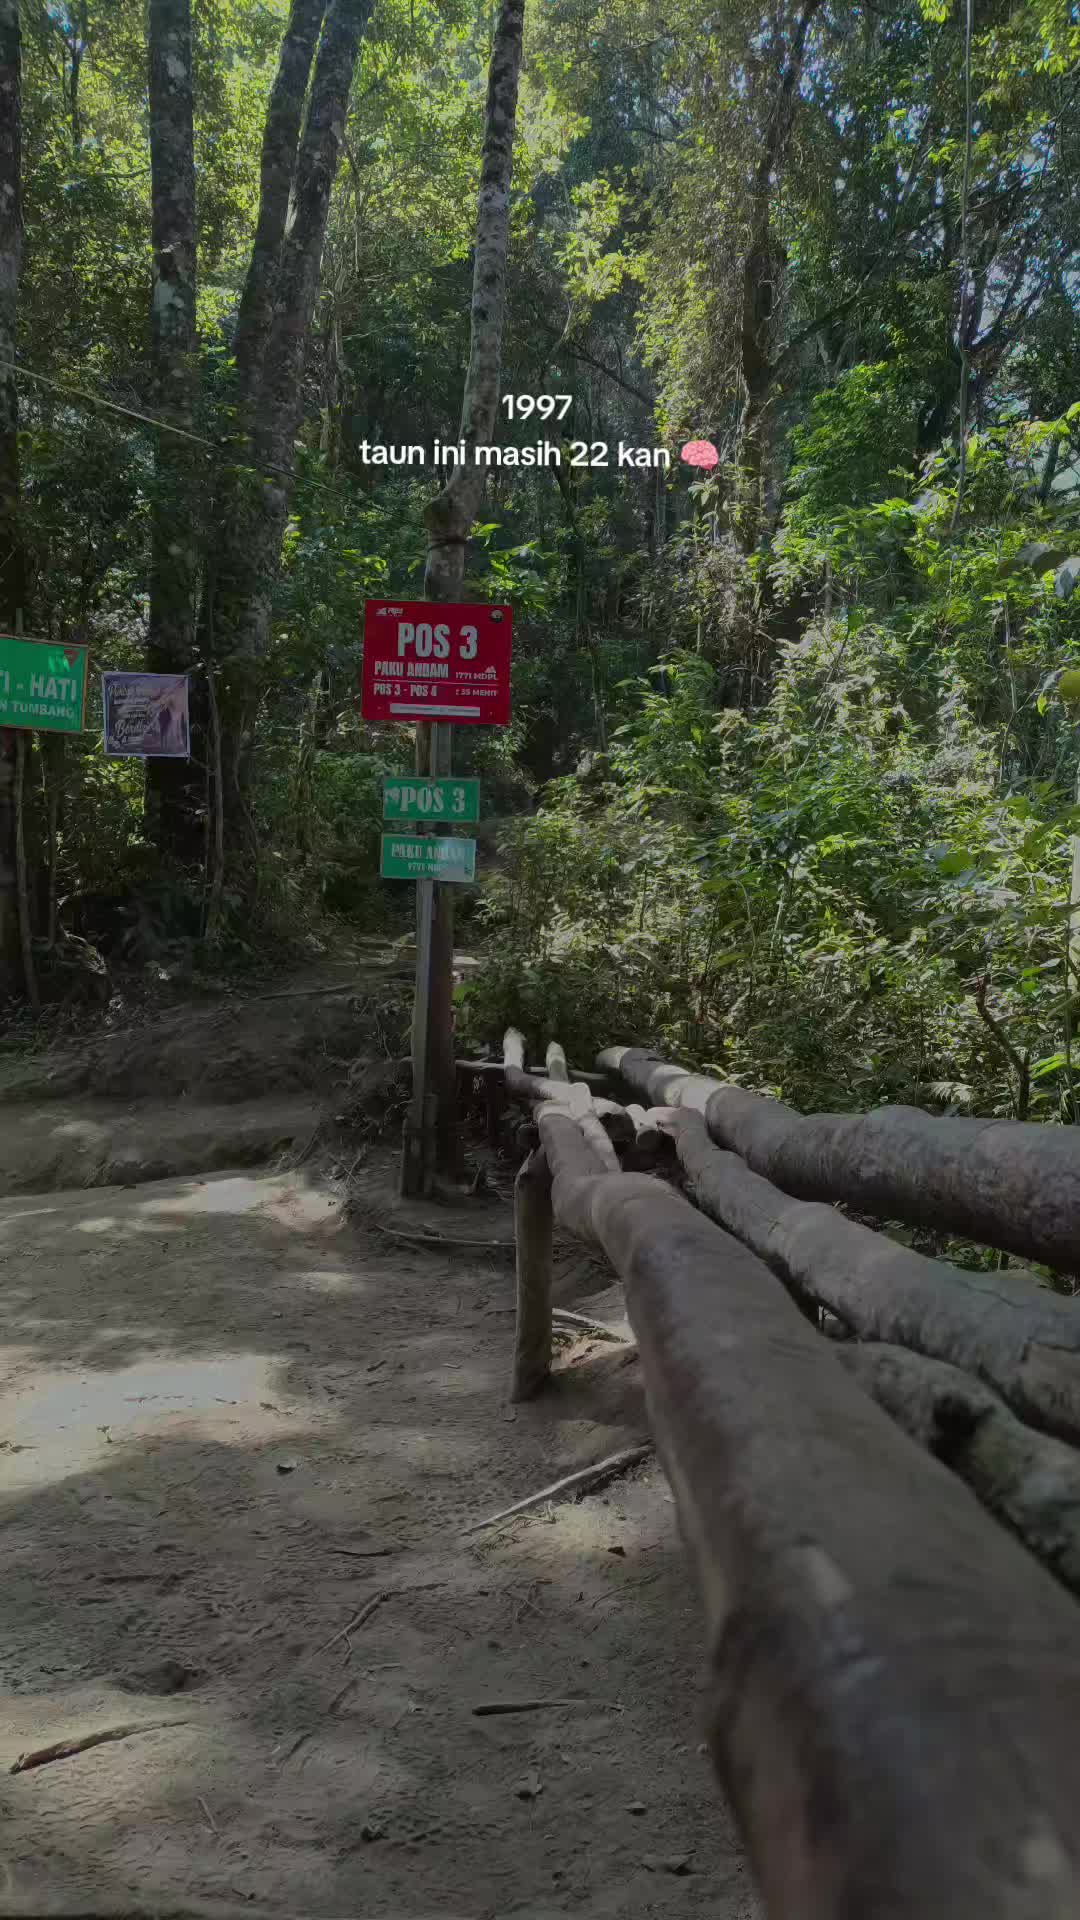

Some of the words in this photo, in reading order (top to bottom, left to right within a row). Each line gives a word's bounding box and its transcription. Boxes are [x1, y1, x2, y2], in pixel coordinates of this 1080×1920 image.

[398, 622, 450, 658] POS
[460, 625, 478, 659] 3
[374, 660, 404, 677] PAKU
[406, 662, 449, 678] ANDAM
[30, 672, 76, 703] HATI
[374, 683, 391, 696] POS
[394, 683, 401, 696] 3
[410, 683, 428, 697] POS
[13, 702, 74, 719] TUMBANG
[400, 786, 444, 813] POS
[452, 787, 465, 813] 3
